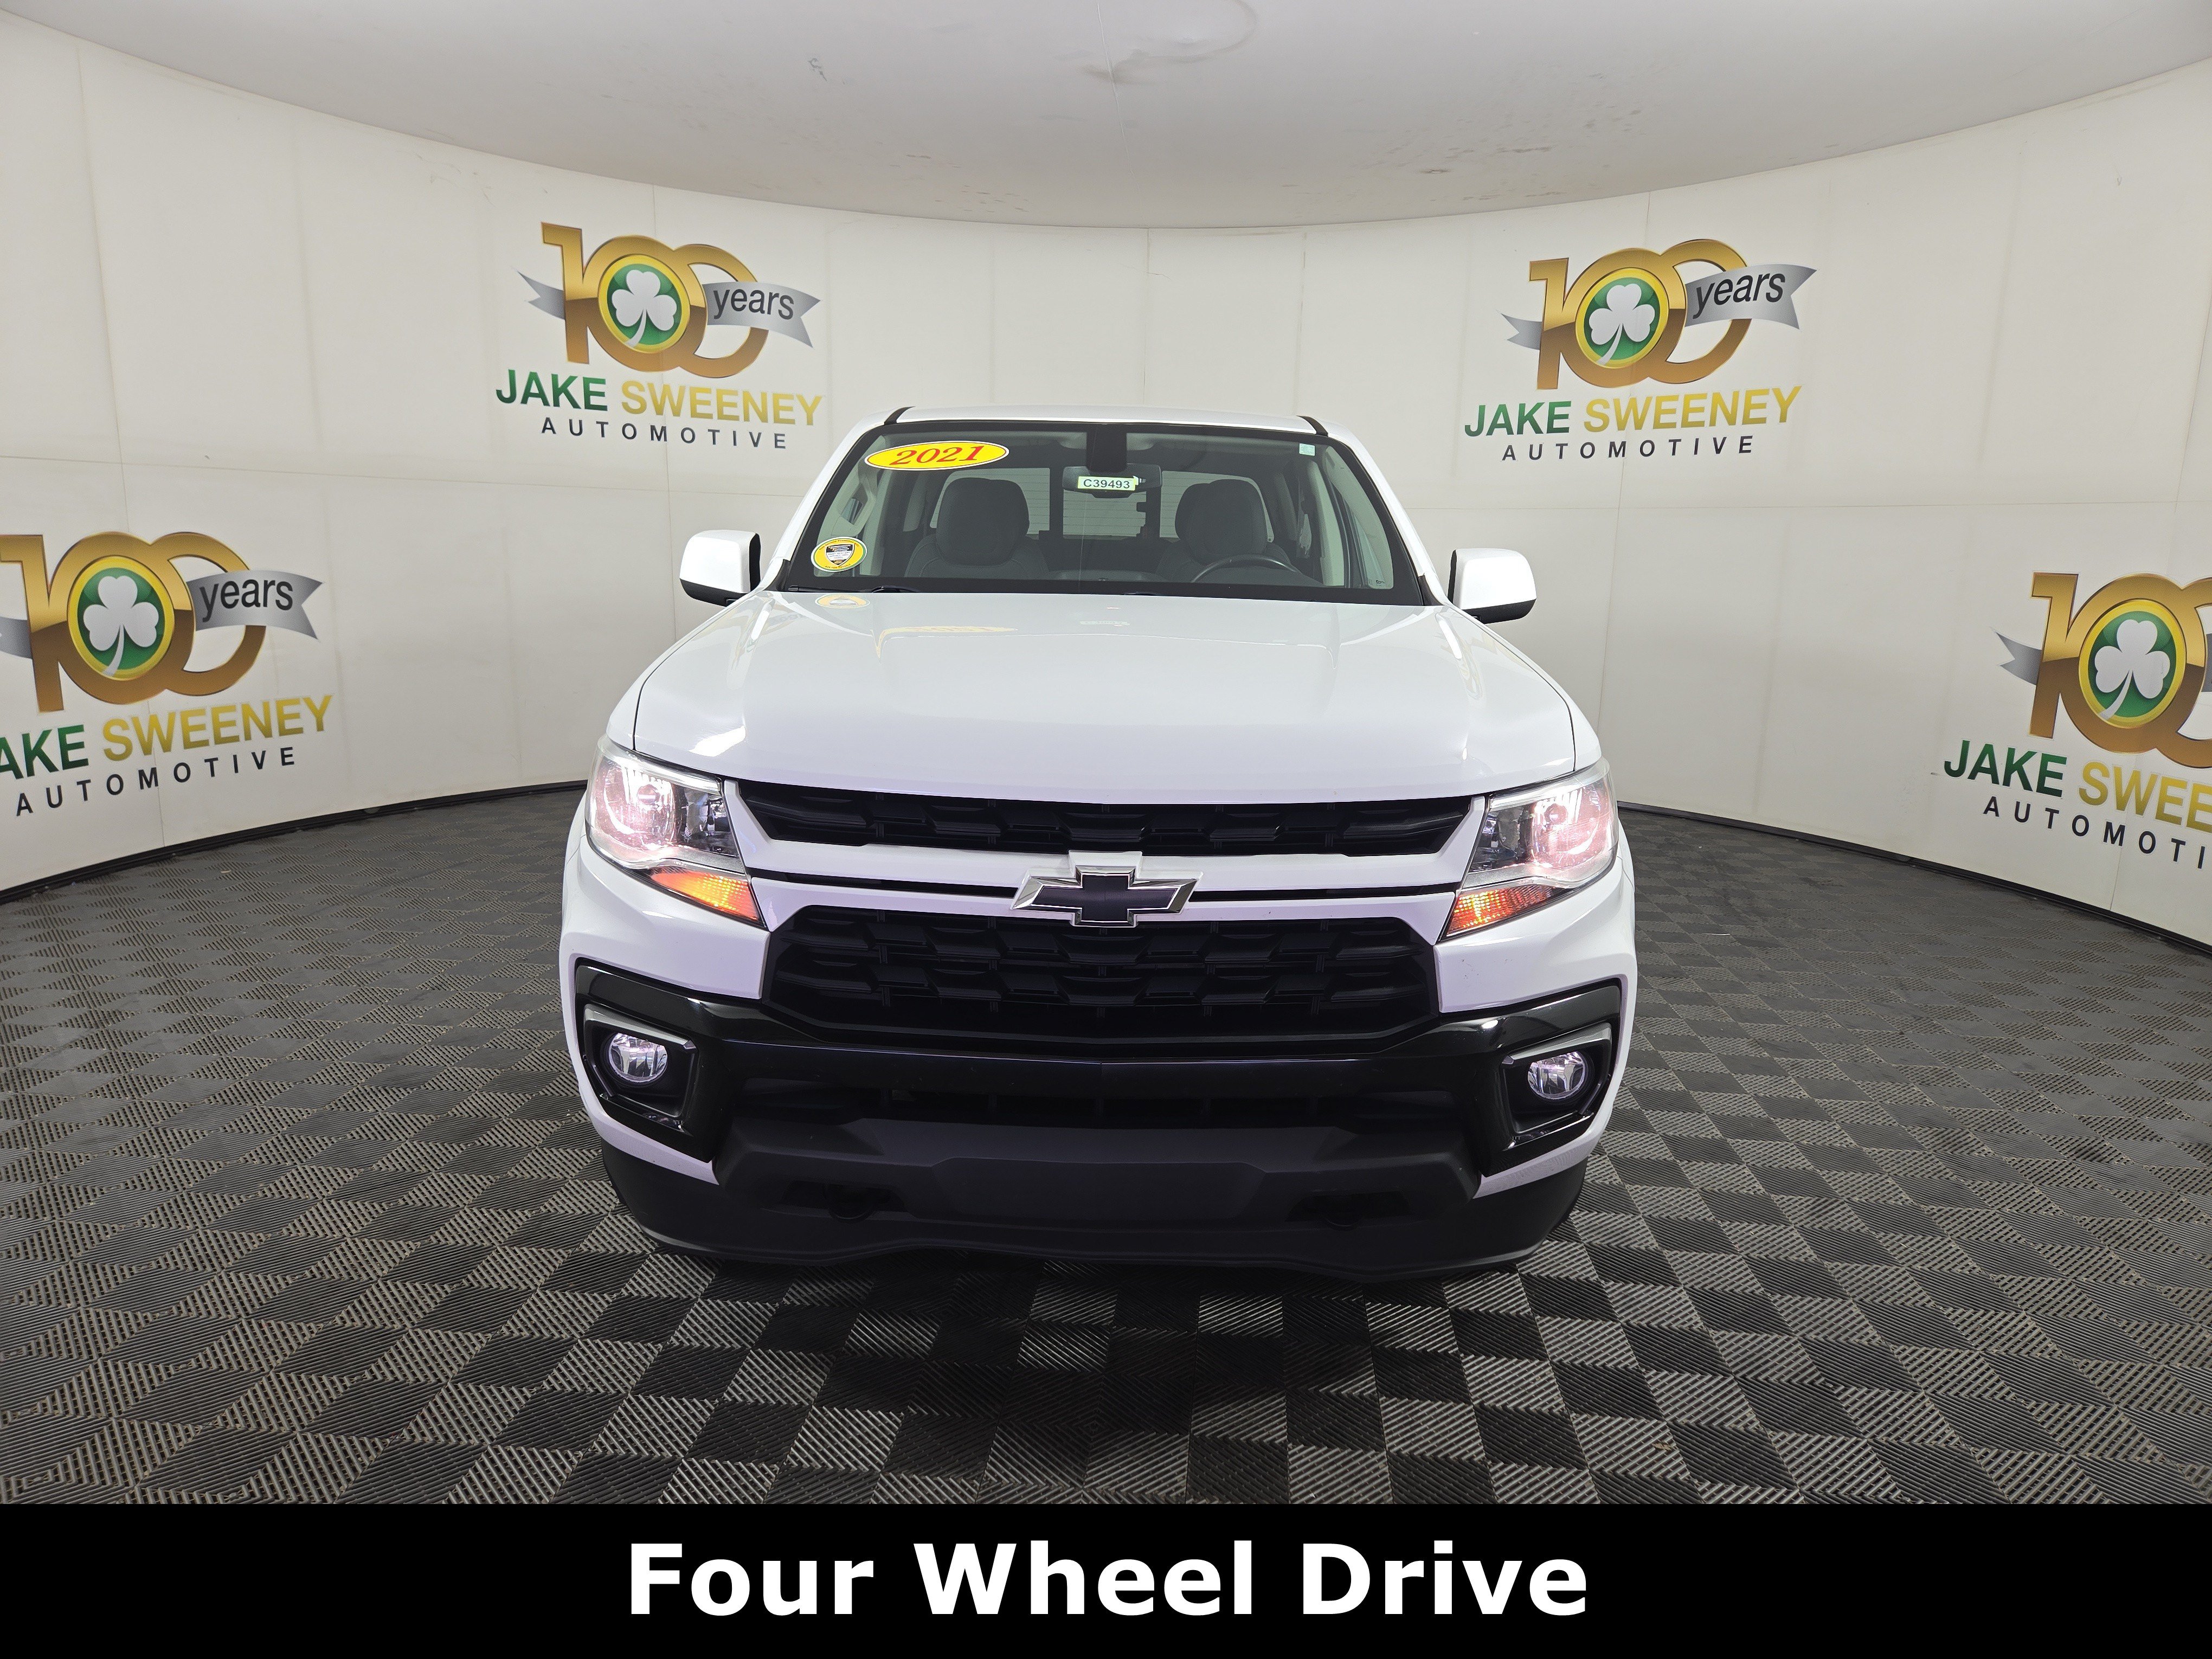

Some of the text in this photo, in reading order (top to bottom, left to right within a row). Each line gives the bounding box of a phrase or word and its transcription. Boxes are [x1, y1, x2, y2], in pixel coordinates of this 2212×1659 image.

[712, 288, 795, 320] years
[1692, 272, 1786, 319] years
[496, 369, 822, 426] JAKE SWEENEY
[1464, 385, 1802, 436] JAKE SWEENEY
[541, 416, 786, 449] AUTOMOTIVE
[889, 445, 985, 465] 2021
[1502, 435, 1753, 461] AUTOMOTIVE
[1083, 479, 1130, 488] C39493
[199, 578, 294, 622] years
[102, 695, 332, 761] SWEENEY
[16, 747, 295, 816] AUTOMOTIVE
[1944, 740, 2212, 833] JAKE SWEE
[1984, 796, 2205, 869] AUTOMOTI
